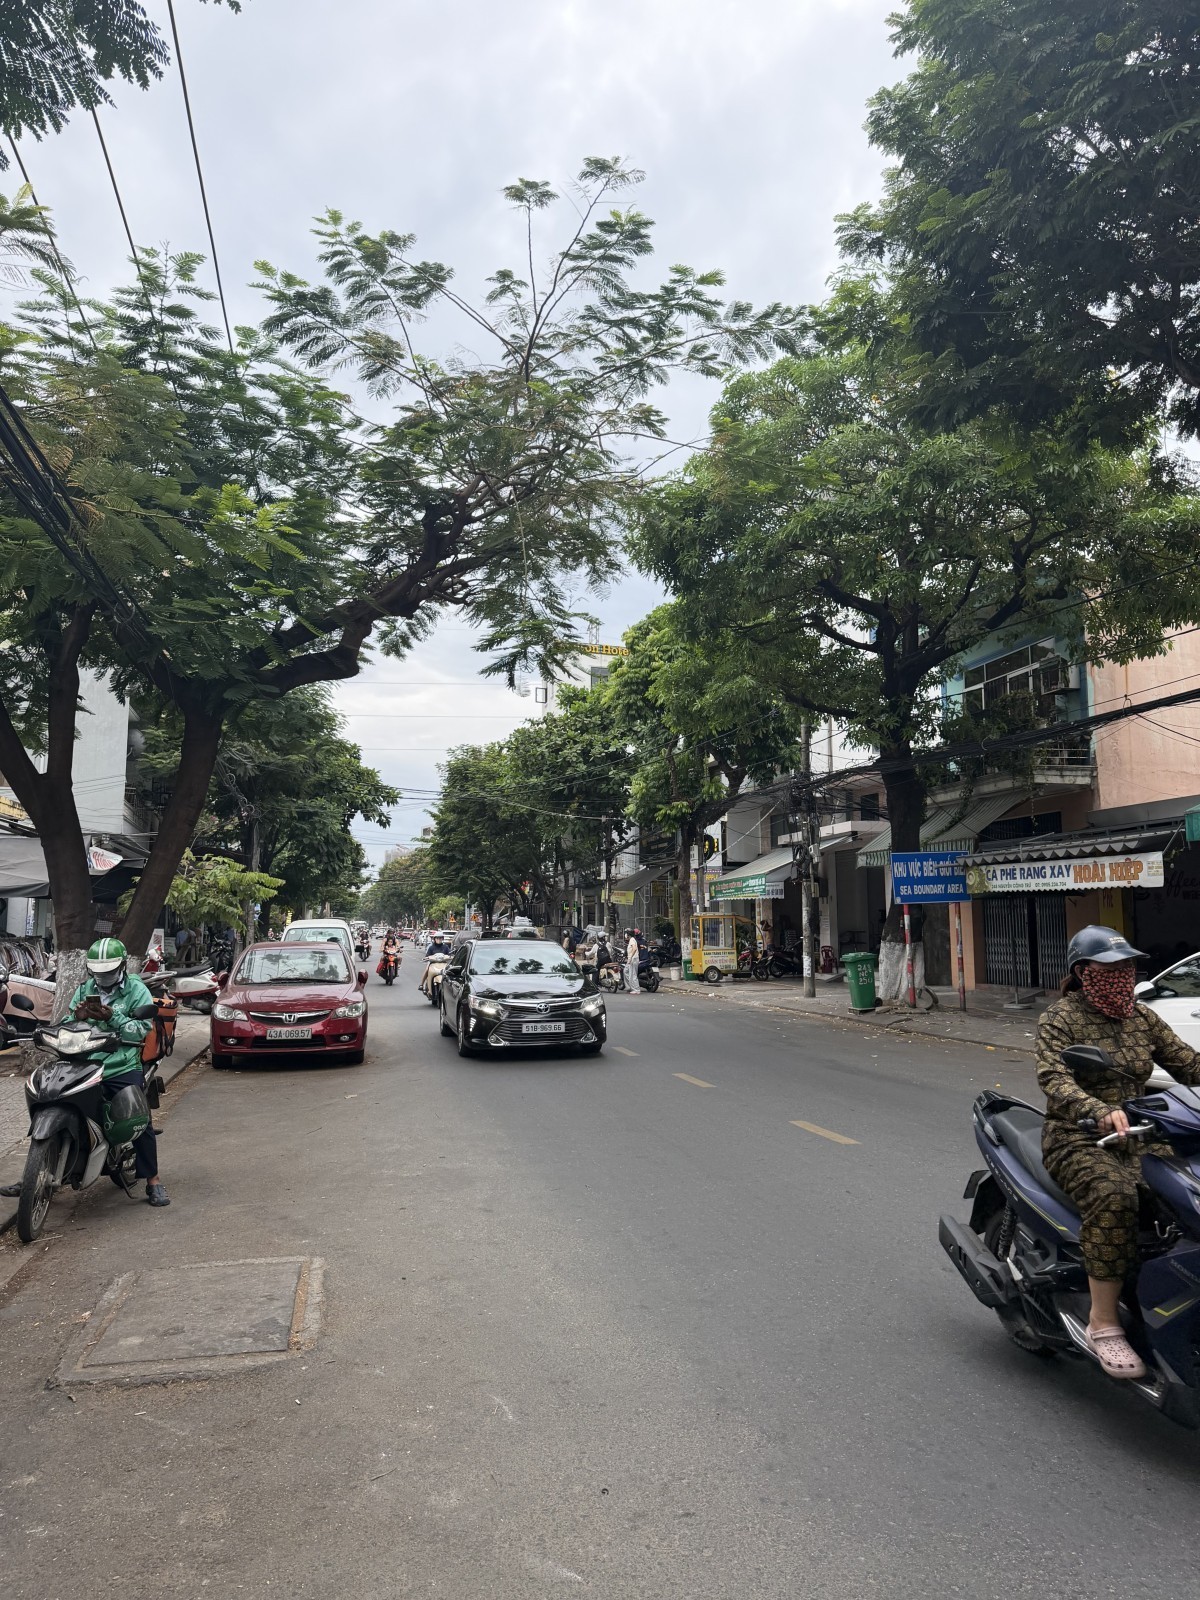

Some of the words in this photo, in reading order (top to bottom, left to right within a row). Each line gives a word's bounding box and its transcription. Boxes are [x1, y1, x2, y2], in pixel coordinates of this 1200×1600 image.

[601, 644, 629, 655] Hote
[986, 866, 998, 881] CÀ
[1000, 865, 1017, 880] PHÊ
[1020, 865, 1047, 880] RANG
[1050, 864, 1072, 878] XAY
[1073, 860, 1106, 883] HOÀI
[1109, 858, 1144, 884] HIỆP
[900, 885, 912, 895] SEA
[913, 884, 945, 895] BOUNDARY
[947, 883, 964, 894] AREA
